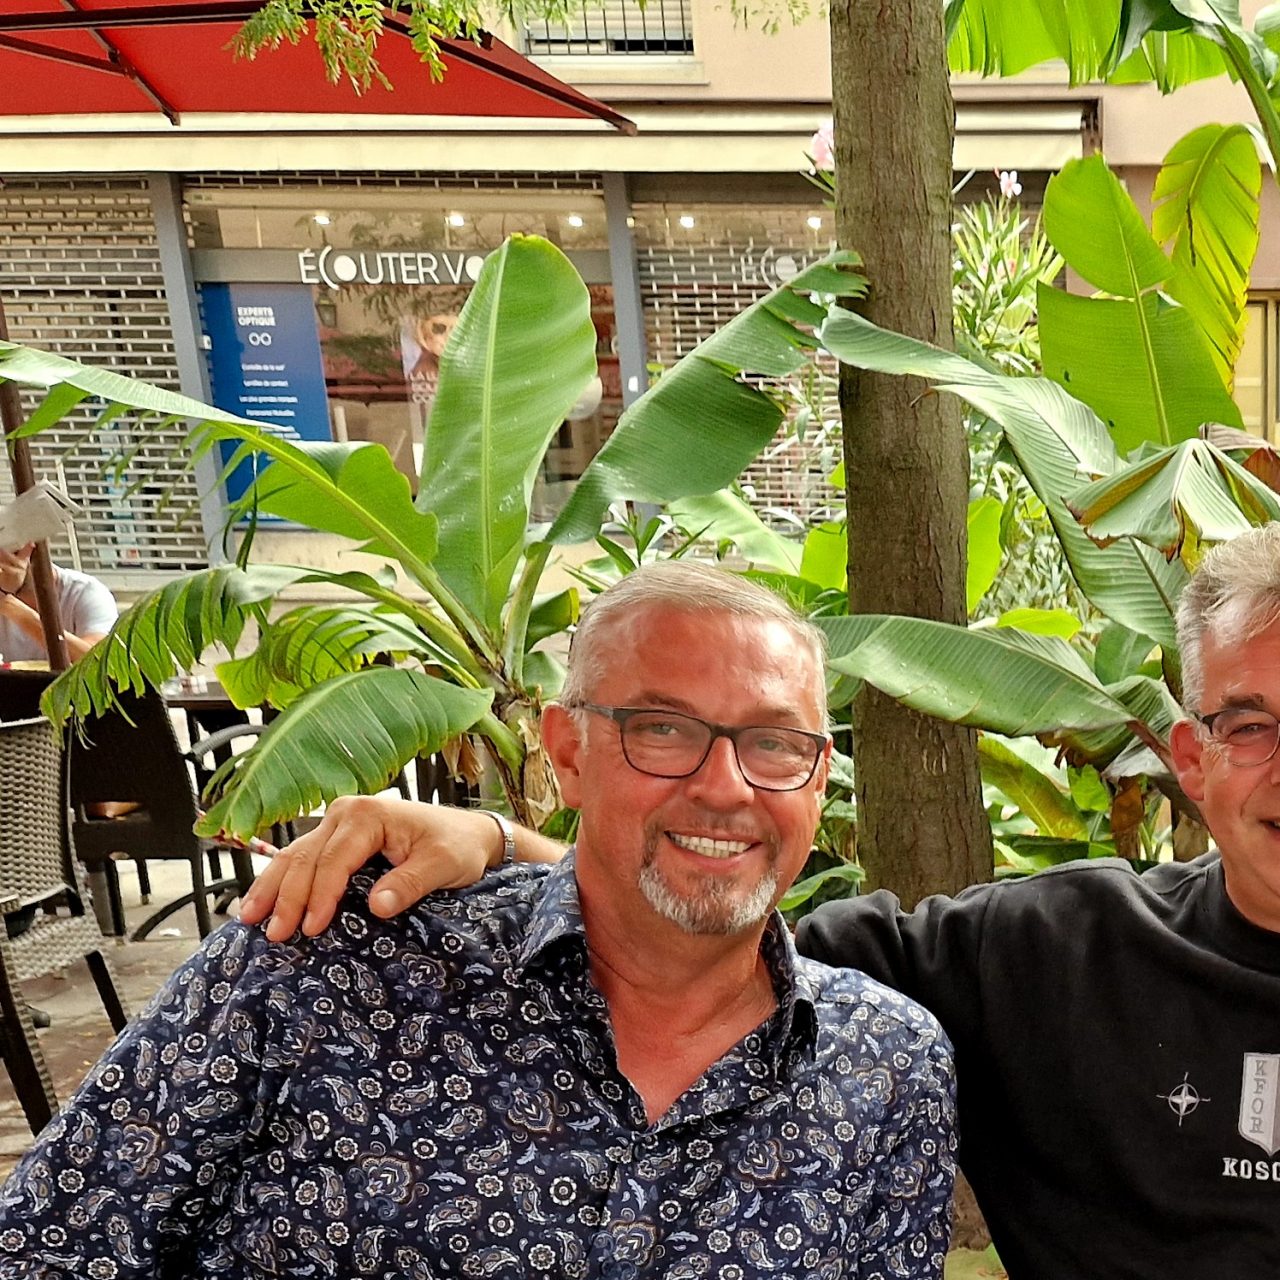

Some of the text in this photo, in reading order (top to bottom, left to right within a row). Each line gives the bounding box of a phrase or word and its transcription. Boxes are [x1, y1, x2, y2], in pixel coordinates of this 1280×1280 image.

[298, 245, 440, 291] ÉCOUTER
[237, 306, 274, 316] EXPERTS
[238, 316, 276, 327] OPTIQUE
[1249, 1059, 1268, 1134] KFOR
